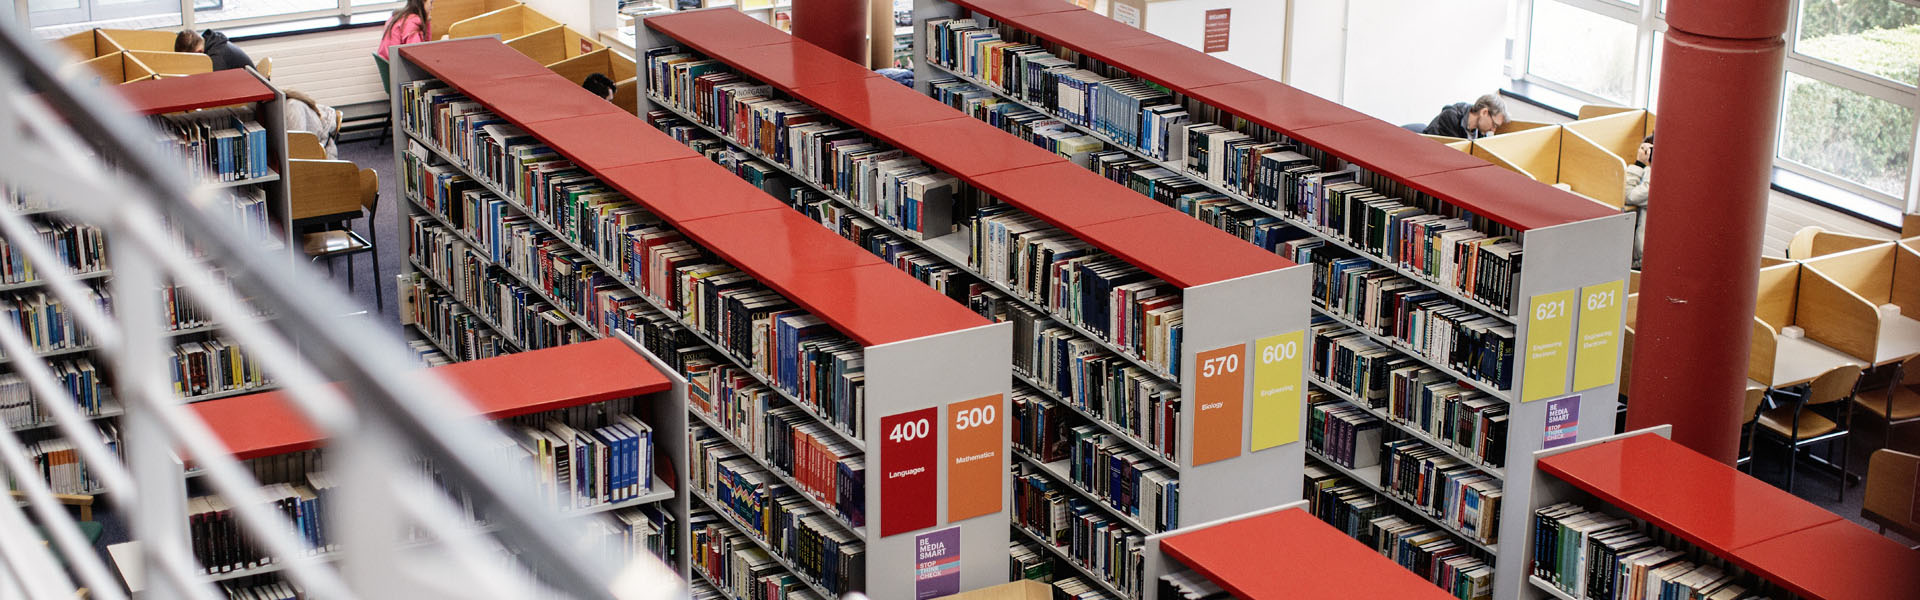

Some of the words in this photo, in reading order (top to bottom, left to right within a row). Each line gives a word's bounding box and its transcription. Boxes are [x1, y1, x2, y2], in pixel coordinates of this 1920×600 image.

[1587, 289, 1616, 311] 621
[1536, 299, 1565, 320] 621
[1263, 341, 1297, 364] 600
[1203, 354, 1239, 378] 570
[1201, 401, 1224, 411] Biology
[1550, 403, 1558, 411] BE
[1550, 407, 1568, 417] MEDIA
[956, 404, 996, 430] 500
[1549, 413, 1569, 423] SMART
[889, 418, 930, 443] 400
[956, 451, 995, 464] Mathematics
[889, 466, 925, 479] Languages
[920, 537, 929, 546] BE
[920, 542, 945, 553] MEDIA
[920, 548, 947, 560] SMART
[920, 560, 937, 569] STOP
[920, 570, 942, 580] CHECK
